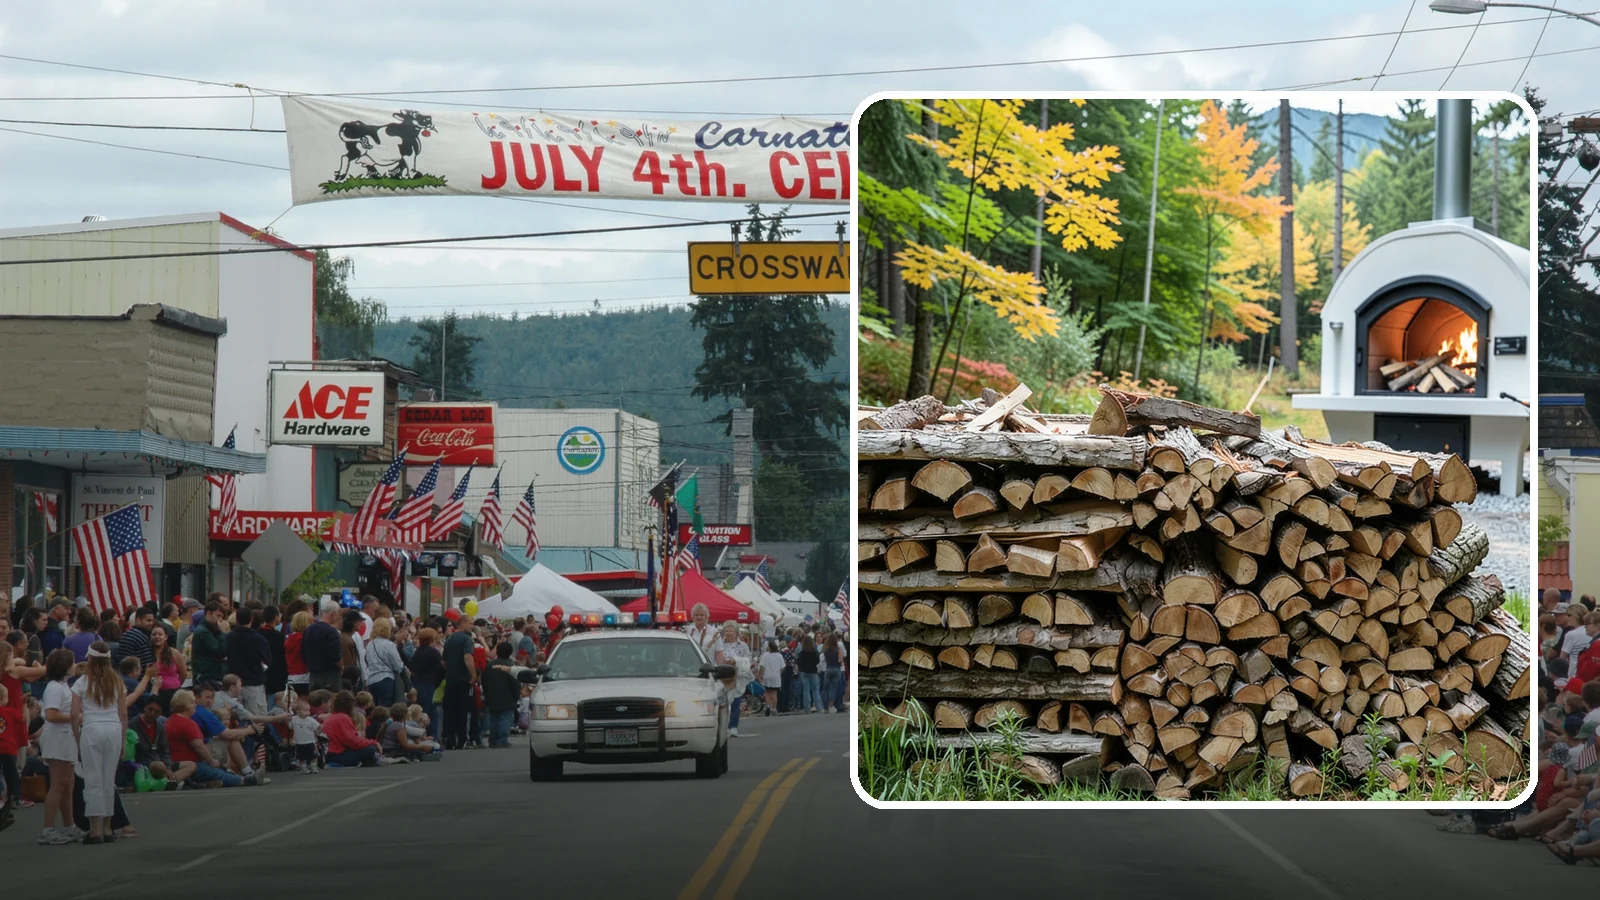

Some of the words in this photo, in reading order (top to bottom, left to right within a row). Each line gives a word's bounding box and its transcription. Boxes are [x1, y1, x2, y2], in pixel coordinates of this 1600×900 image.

[695, 121, 850, 150] Carnat
[481, 141, 605, 193] JULY
[632, 149, 747, 198] 4th.
[697, 254, 850, 280] CROSSWA
[283, 379, 374, 420] ACE
[406, 409, 453, 422] CEDAR
[283, 421, 371, 436] Hardware
[416, 428, 477, 447] Coca-Cola
[353, 467, 384, 480] Simpl
[83, 485, 93, 494] St.
[95, 485, 124, 495] Vincent
[126, 486, 136, 495] de
[138, 485, 155, 495] Paul
[688, 526, 741, 535] CRNATION
[699, 535, 730, 543] GLASS
